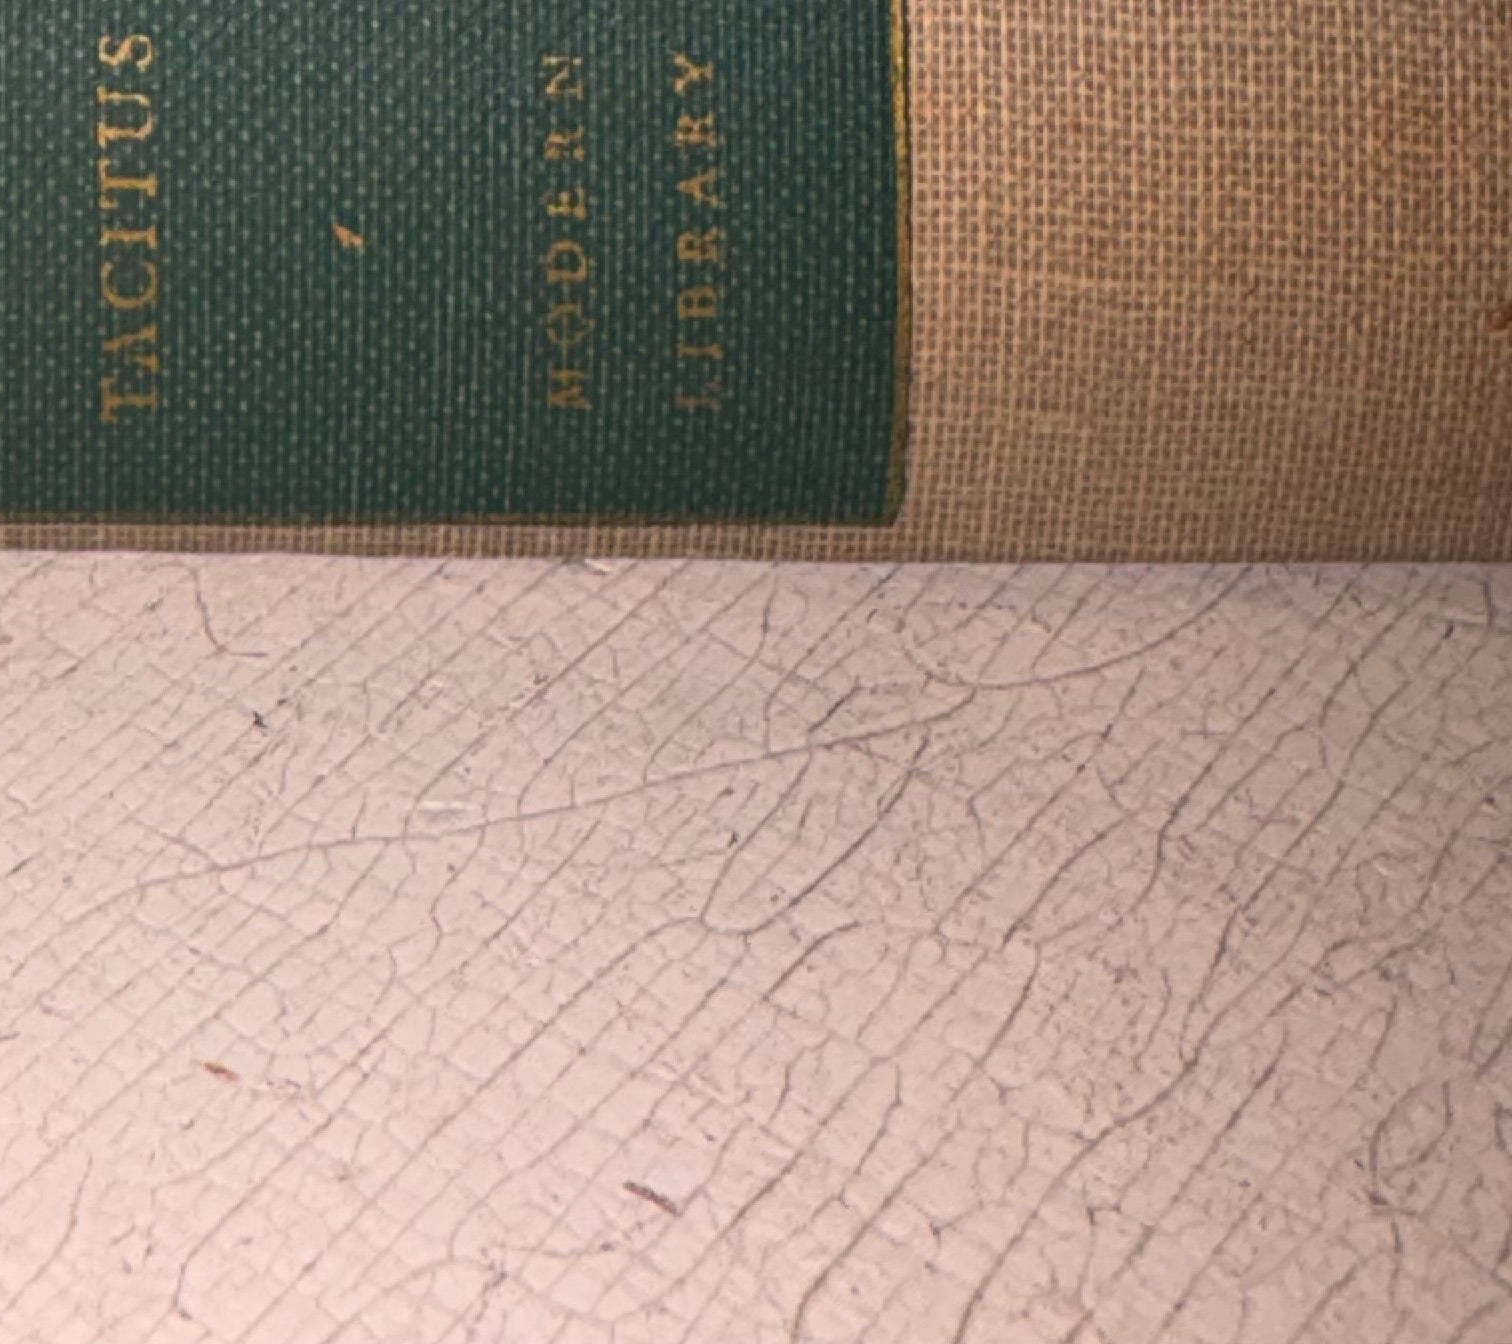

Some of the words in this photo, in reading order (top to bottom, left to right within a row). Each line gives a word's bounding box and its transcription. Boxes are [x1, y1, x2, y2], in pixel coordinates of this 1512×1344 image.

[98, 32, 160, 425] TACITUS
[538, 52, 592, 413] MODERN
[671, 45, 725, 413] LIBRARY
